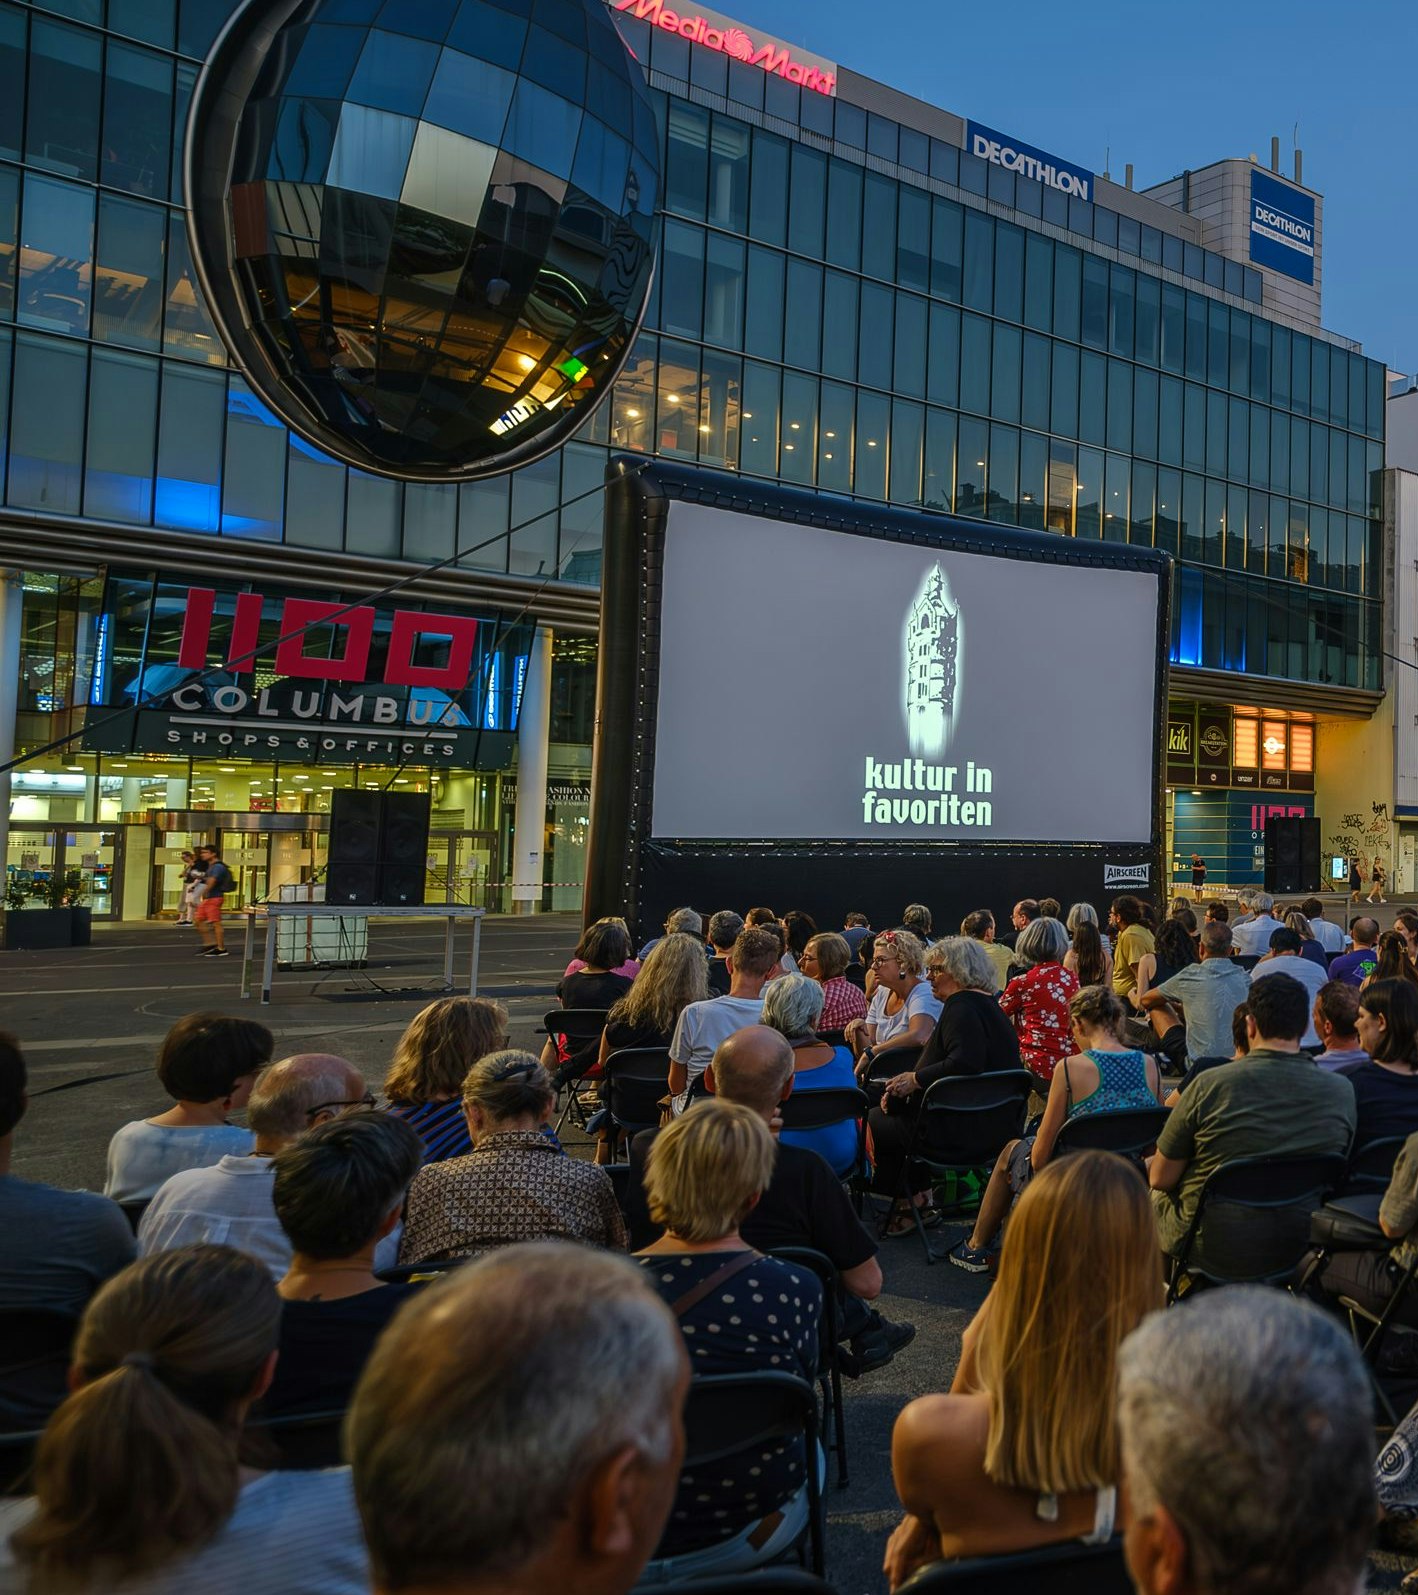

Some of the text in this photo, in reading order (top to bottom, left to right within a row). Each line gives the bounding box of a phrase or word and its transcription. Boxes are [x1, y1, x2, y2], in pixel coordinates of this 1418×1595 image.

[616, 0, 836, 96] Media Markt
[973, 133, 1088, 201] DECATHLON
[1255, 206, 1311, 242] DECATHLON
[179, 587, 478, 690] 1100
[173, 683, 462, 727] COLUMBUS
[167, 730, 454, 756] SHOPS & OFFICES
[1169, 726, 1188, 751] kik
[865, 756, 992, 793] kultur in
[862, 791, 992, 826] favoriten
[1106, 866, 1147, 880] AIRSCREEN
